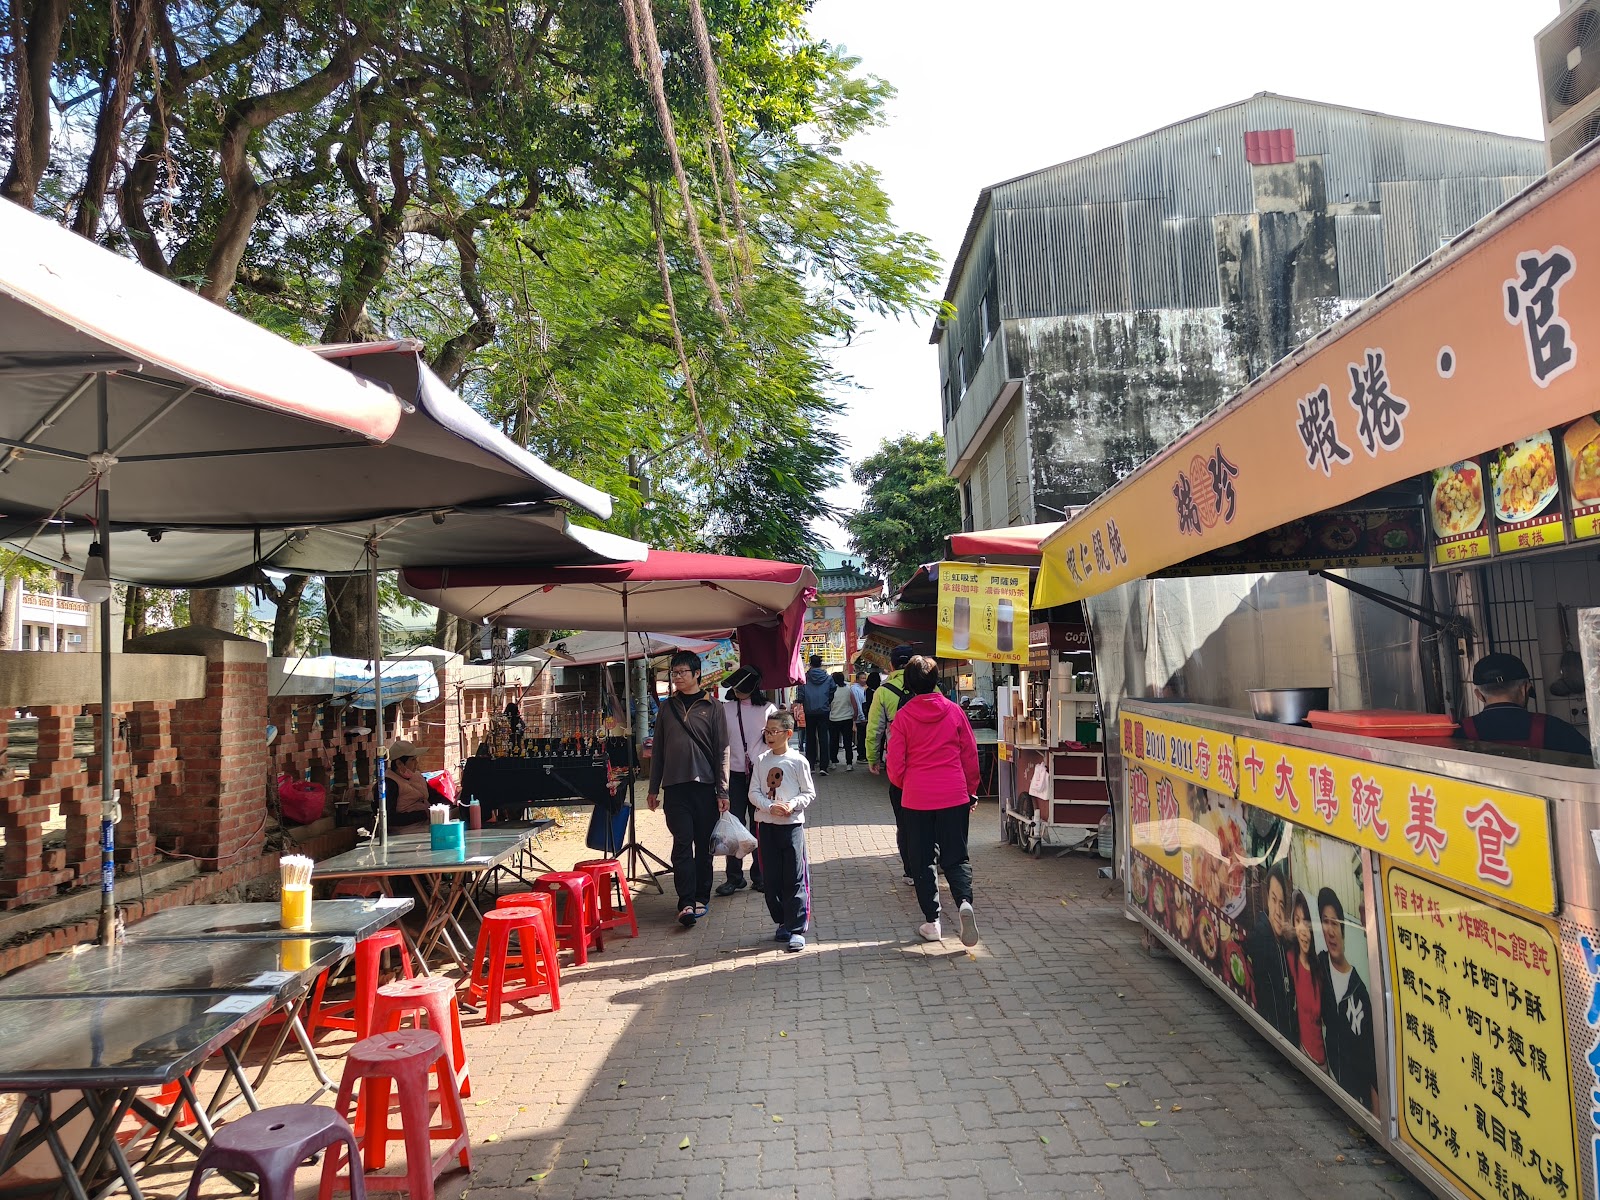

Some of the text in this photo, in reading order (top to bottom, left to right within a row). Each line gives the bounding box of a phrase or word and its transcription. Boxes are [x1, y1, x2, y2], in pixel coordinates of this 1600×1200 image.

[1300, 352, 1408, 473] 蝦捲
[1446, 541, 1479, 560] 蚵仔煎
[1517, 529, 1544, 547] 蝦捲
[943, 583, 979, 594] 拿鐵咖啡
[952, 573, 978, 583] 虹吸式
[985, 586, 1025, 597] 濃香鮮奶茶
[991, 576, 1019, 586] 阿薩姆
[1065, 631, 1089, 645] Coff
[1145, 730, 1166, 762] 2010
[1170, 736, 1194, 771] 2011
[1397, 925, 1546, 1024] 蚵仔煎 炸蚵仔酥
[1402, 967, 1551, 1082] 蝦仁煎 蚵仔麵線
[1405, 1012, 1438, 1053] 蝦捲
[1407, 1055, 1569, 1199] 蚵捲 虱目魚丸湯
[1408, 1096, 1541, 1200] 蚵仔湯 魚鬆肉
